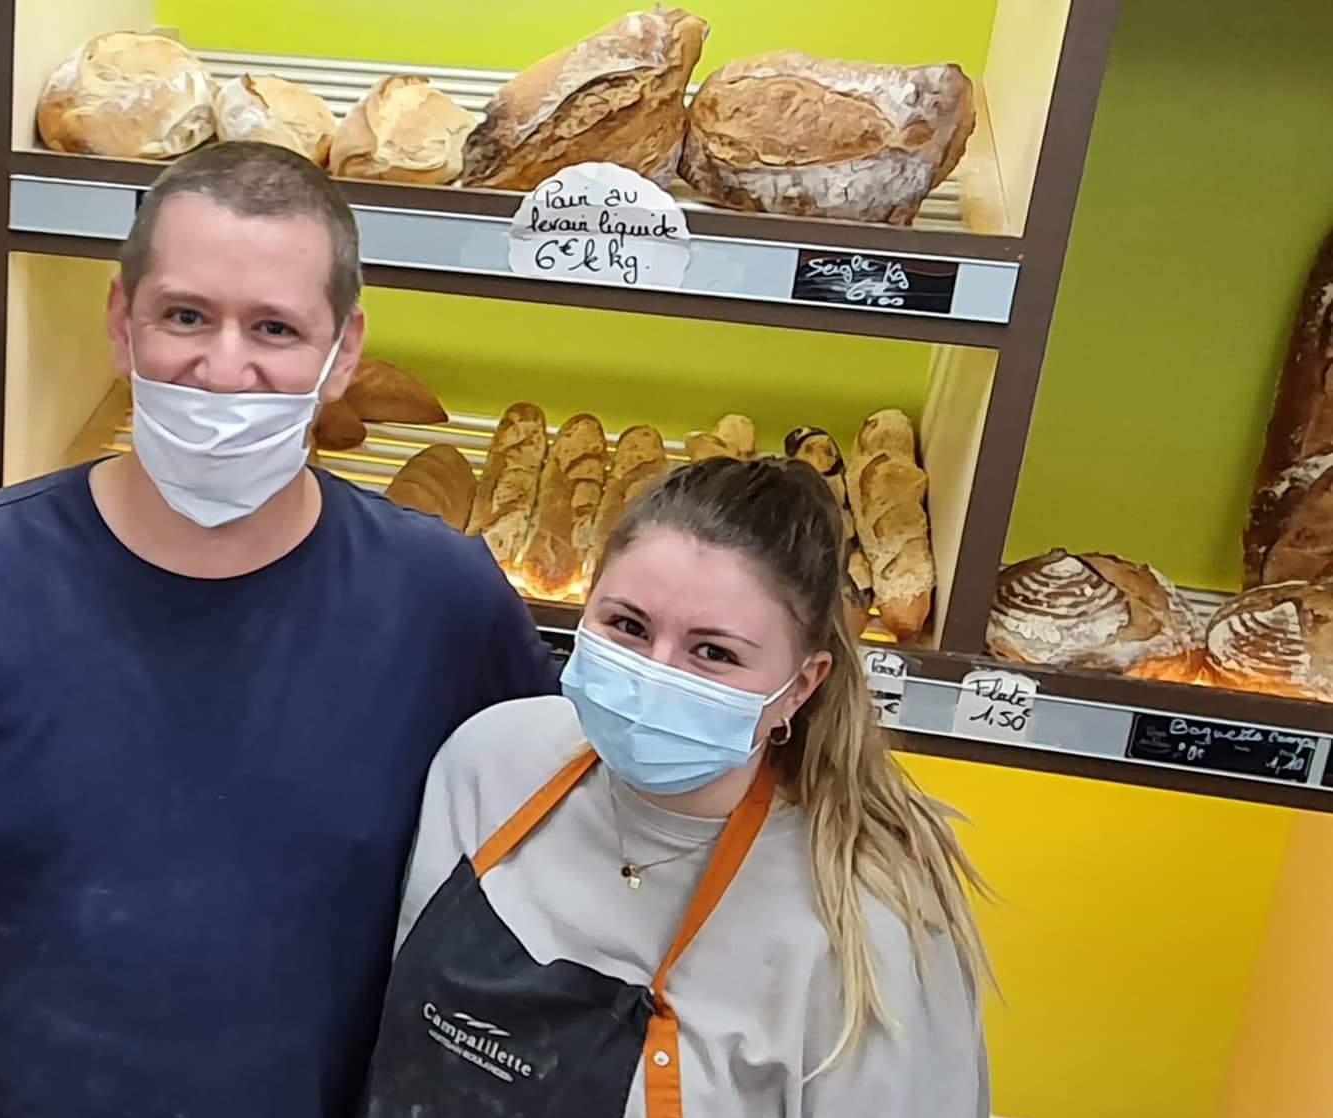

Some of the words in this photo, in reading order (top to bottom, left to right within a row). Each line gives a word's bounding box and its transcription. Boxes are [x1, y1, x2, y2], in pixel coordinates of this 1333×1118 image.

[533, 180, 590, 209] Pain
[604, 188, 638, 207] au
[526, 206, 589, 233] levain
[599, 210, 678, 248] liquide
[806, 255, 877, 283] Seigle
[423, 1002, 532, 1077] Campaillette
